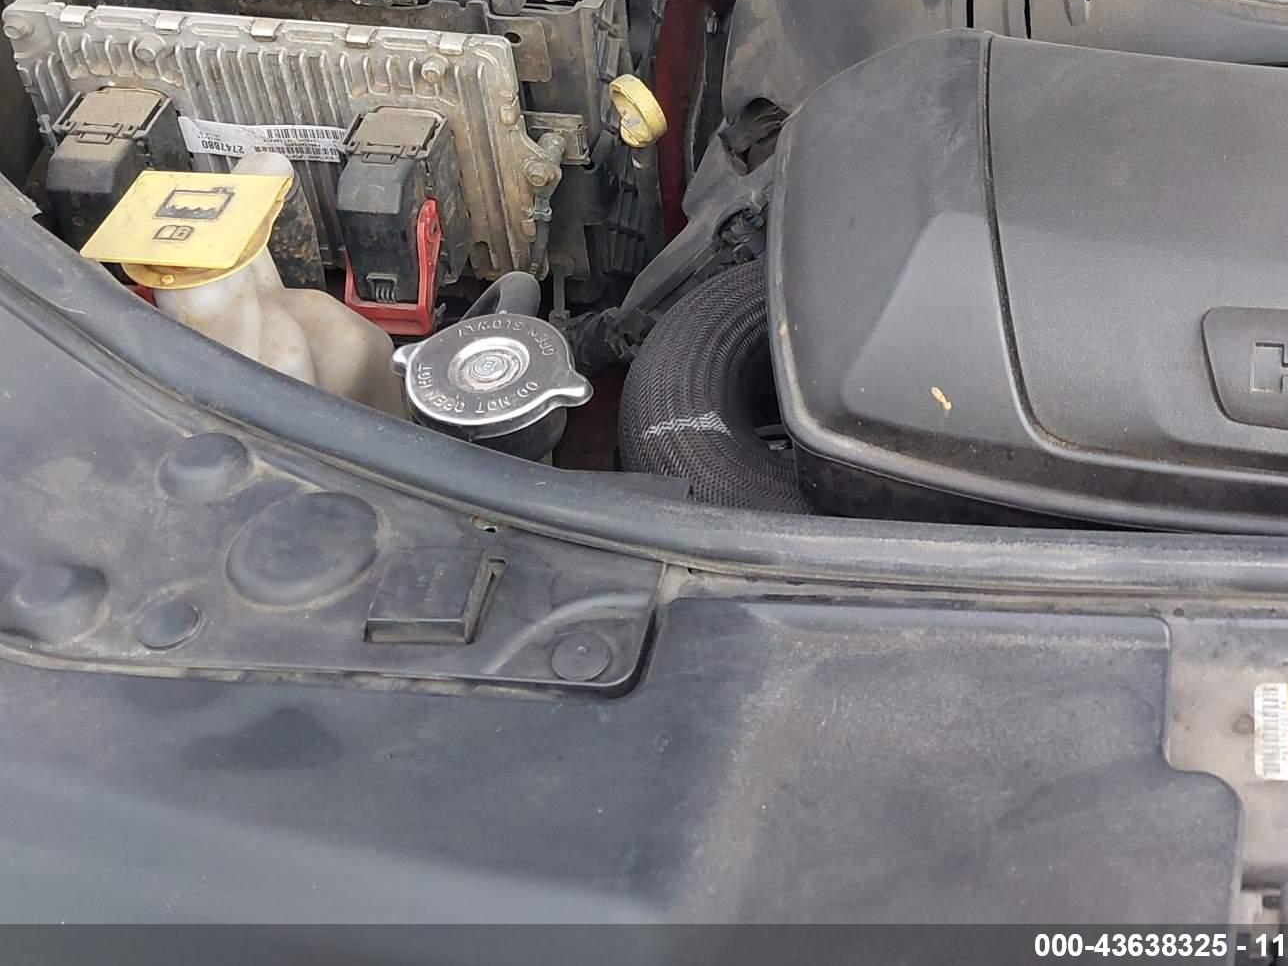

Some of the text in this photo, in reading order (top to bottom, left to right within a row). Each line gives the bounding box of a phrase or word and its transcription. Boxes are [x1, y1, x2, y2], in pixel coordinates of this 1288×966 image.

[416, 363, 433, 389] HOT
[517, 381, 541, 398] DO
[475, 395, 512, 414] NOT
